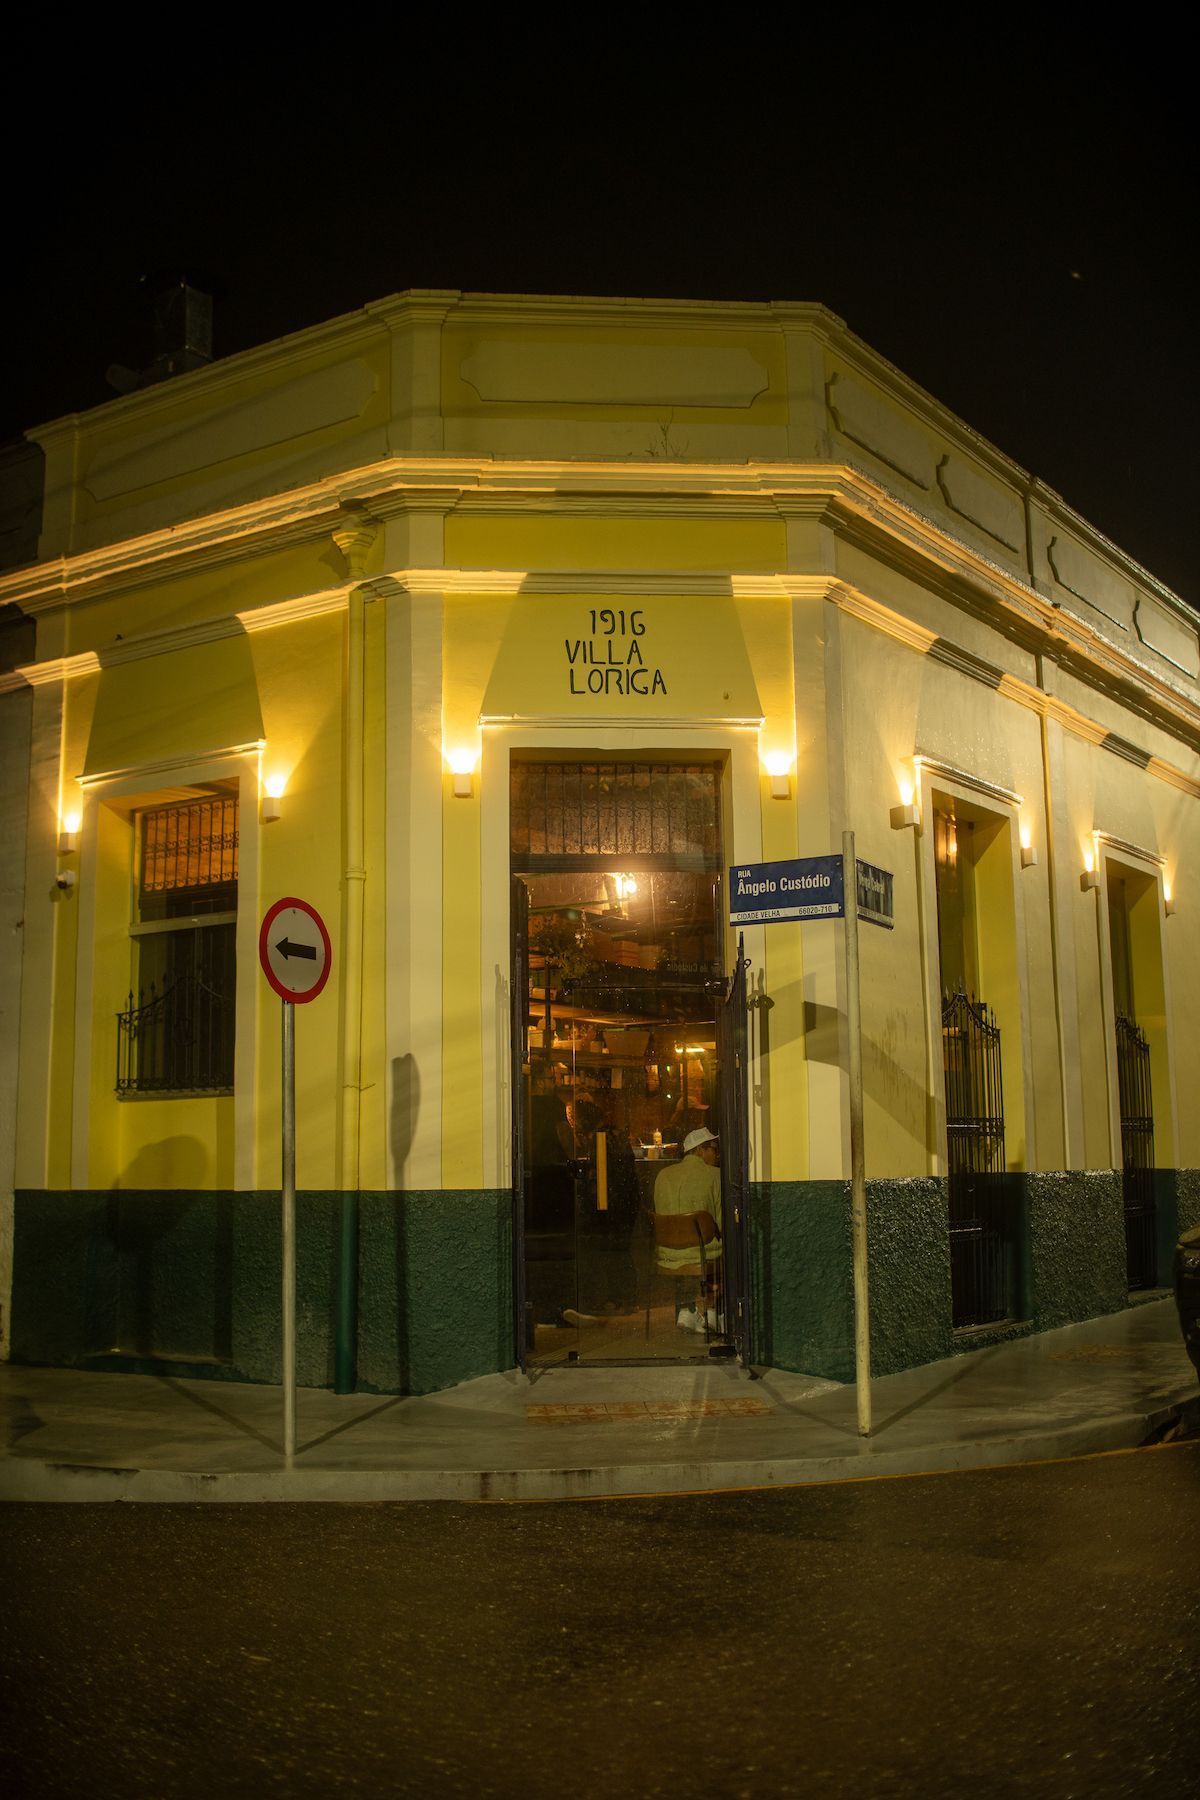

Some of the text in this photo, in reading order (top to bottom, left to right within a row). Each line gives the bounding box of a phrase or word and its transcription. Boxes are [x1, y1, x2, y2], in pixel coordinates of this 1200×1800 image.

[589, 609, 646, 636] 1916
[565, 639, 643, 665] VILLA
[570, 668, 667, 695] LORIGA
[737, 869, 751, 879] RUA
[737, 874, 831, 897] Ângelo Custódio
[737, 911, 760, 921] CIDADE
[760, 910, 781, 919] VELHA
